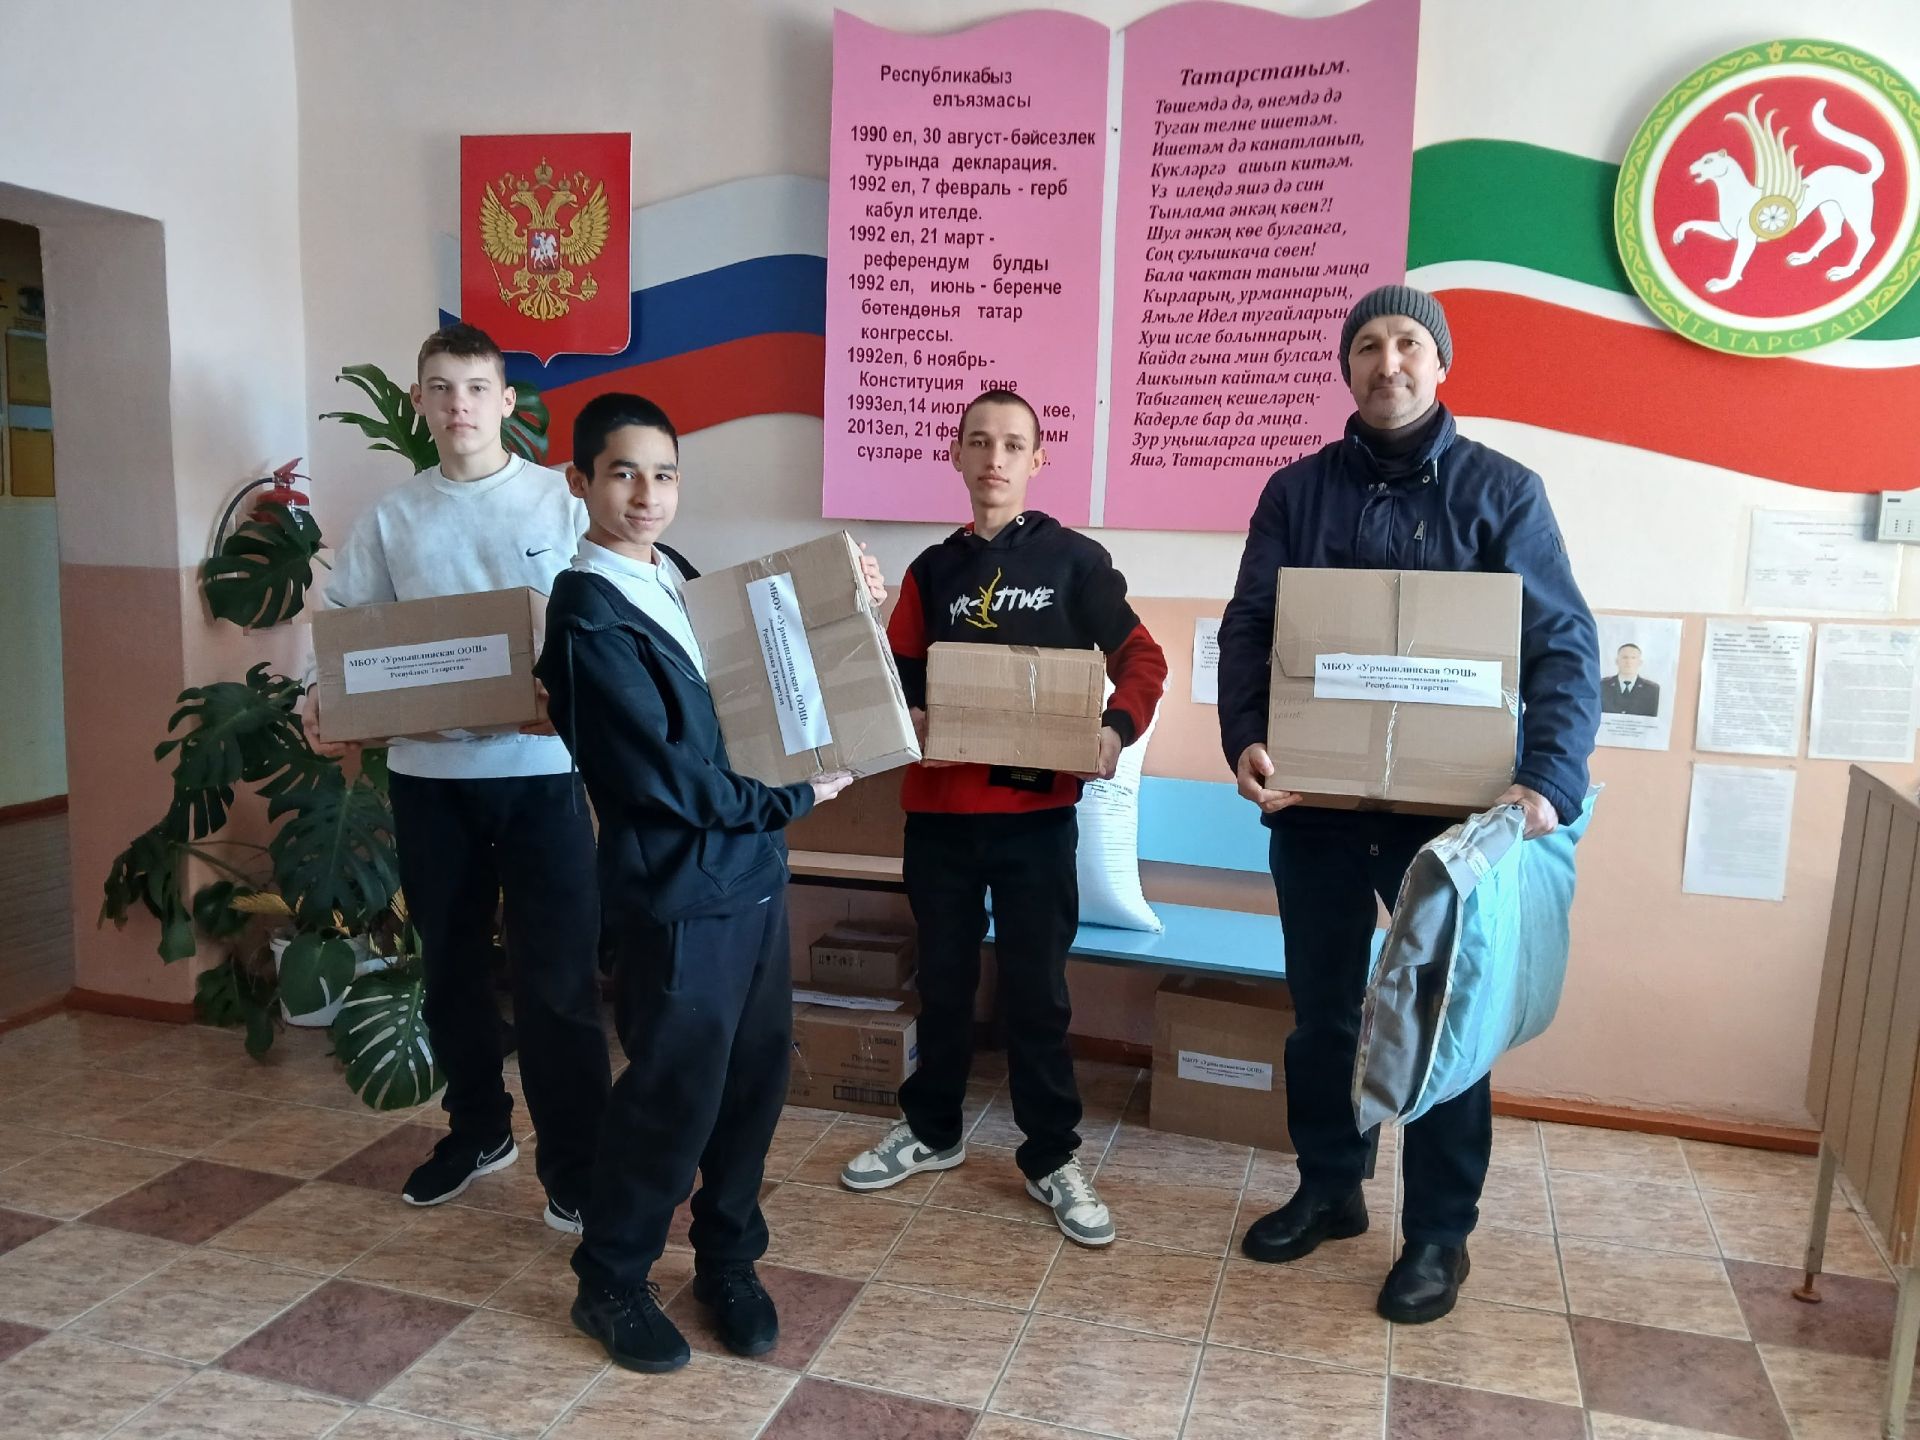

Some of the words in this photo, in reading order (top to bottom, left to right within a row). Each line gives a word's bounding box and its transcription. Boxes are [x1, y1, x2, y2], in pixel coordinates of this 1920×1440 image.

[881, 65, 1012, 87] Республикабыз
[1180, 60, 1350, 88] Татарстаным.
[933, 94, 1031, 108] елъязмасы
[1156, 96, 1228, 114] Төшемдә
[1232, 95, 1253, 111] дә,
[1258, 89, 1320, 109] өнемдә
[1323, 87, 1342, 103] дә
[851, 125, 887, 142] 1990
[893, 130, 917, 146] ел,
[923, 127, 941, 144] 30
[1155, 121, 1200, 139] Туган
[1204, 119, 1257, 133] телне
[1261, 114, 1337, 130] ишетәм.
[1152, 141, 1224, 157] Ишетәм
[1228, 137, 1246, 153] дә
[1250, 133, 1364, 152] канатланып,
[866, 154, 939, 171] турында
[952, 157, 1056, 174] декларация.
[1238, 160, 1286, 174] ашып
[1291, 156, 1353, 171] китәм.
[850, 174, 886, 192] 1992
[891, 180, 915, 196] ел,
[922, 177, 930, 194] 7
[936, 178, 1011, 199] февраль
[1031, 178, 1067, 200] герб
[1152, 184, 1167, 198] Үз
[1176, 181, 1233, 199] илеңдә
[1235, 183, 1270, 195] яшә
[1274, 179, 1292, 193] дә
[1296, 180, 1324, 192] син
[866, 201, 913, 222] кабул
[920, 207, 982, 222] ителде.
[1149, 205, 1225, 219] Тынлама
[1229, 204, 1276, 218] әнкәң
[849, 225, 885, 242] 1992
[891, 230, 914, 245] ел,
[920, 227, 937, 244] 21
[944, 232, 984, 249] март
[1147, 226, 1181, 244] Шул
[1185, 227, 1231, 240] әнкәң
[1235, 226, 1263, 238] көе
[1267, 222, 1346, 239] булганга,
[864, 251, 969, 273] референдум
[993, 254, 1048, 273] булды
[1146, 247, 1173, 263] Соң
[1178, 246, 1275, 265] сулышкача
[1275, 242, 1316, 258] сөен!
[1145, 268, 1184, 282] Бала
[1189, 269, 1252, 281] чактан
[1256, 266, 1320, 279] таныш
[1323, 263, 1369, 278] миңа
[849, 273, 884, 291] 1992
[890, 279, 914, 295] ел,
[931, 281, 975, 294] июнь
[993, 277, 1062, 299] беренче
[1143, 289, 1235, 307] Кырларың,
[1237, 286, 1352, 305] урманнарың,
[861, 298, 960, 319] бөтендөнья
[978, 306, 1022, 322] татар
[1142, 310, 1194, 323] Ямьле
[1197, 308, 1238, 323] Идел
[861, 327, 953, 344] конгрессы.
[1138, 330, 1170, 347] Хуш
[1175, 333, 1211, 344] исле
[1215, 329, 1327, 344] болыннарың.
[1691, 308, 1867, 352] ТАТАРСТАН
[914, 349, 922, 365] 6
[1138, 350, 1186, 365] Кайда
[1190, 353, 1231, 364] гына
[1234, 352, 1269, 363] мин
[1274, 348, 1333, 367] булсам
[860, 370, 963, 393] Конституция
[981, 379, 1017, 392] көне
[1136, 371, 1217, 385] Ашкынып
[1221, 370, 1290, 384] кайтам
[1136, 392, 1222, 408] Табигатең
[931, 402, 970, 415] июл
[1043, 405, 1075, 420] көе,
[1134, 412, 1198, 430] Кадерле
[1203, 411, 1231, 429] бар
[1235, 411, 1254, 425] да
[915, 421, 930, 437] 21
[1132, 432, 1159, 450] Зур
[1161, 436, 1256, 450] уңышларга
[858, 446, 922, 463] сүзләре
[1130, 453, 1166, 468] Яшә,
[768, 582, 782, 612] МБОУ
[1321, 662, 1354, 671] МБОУ
